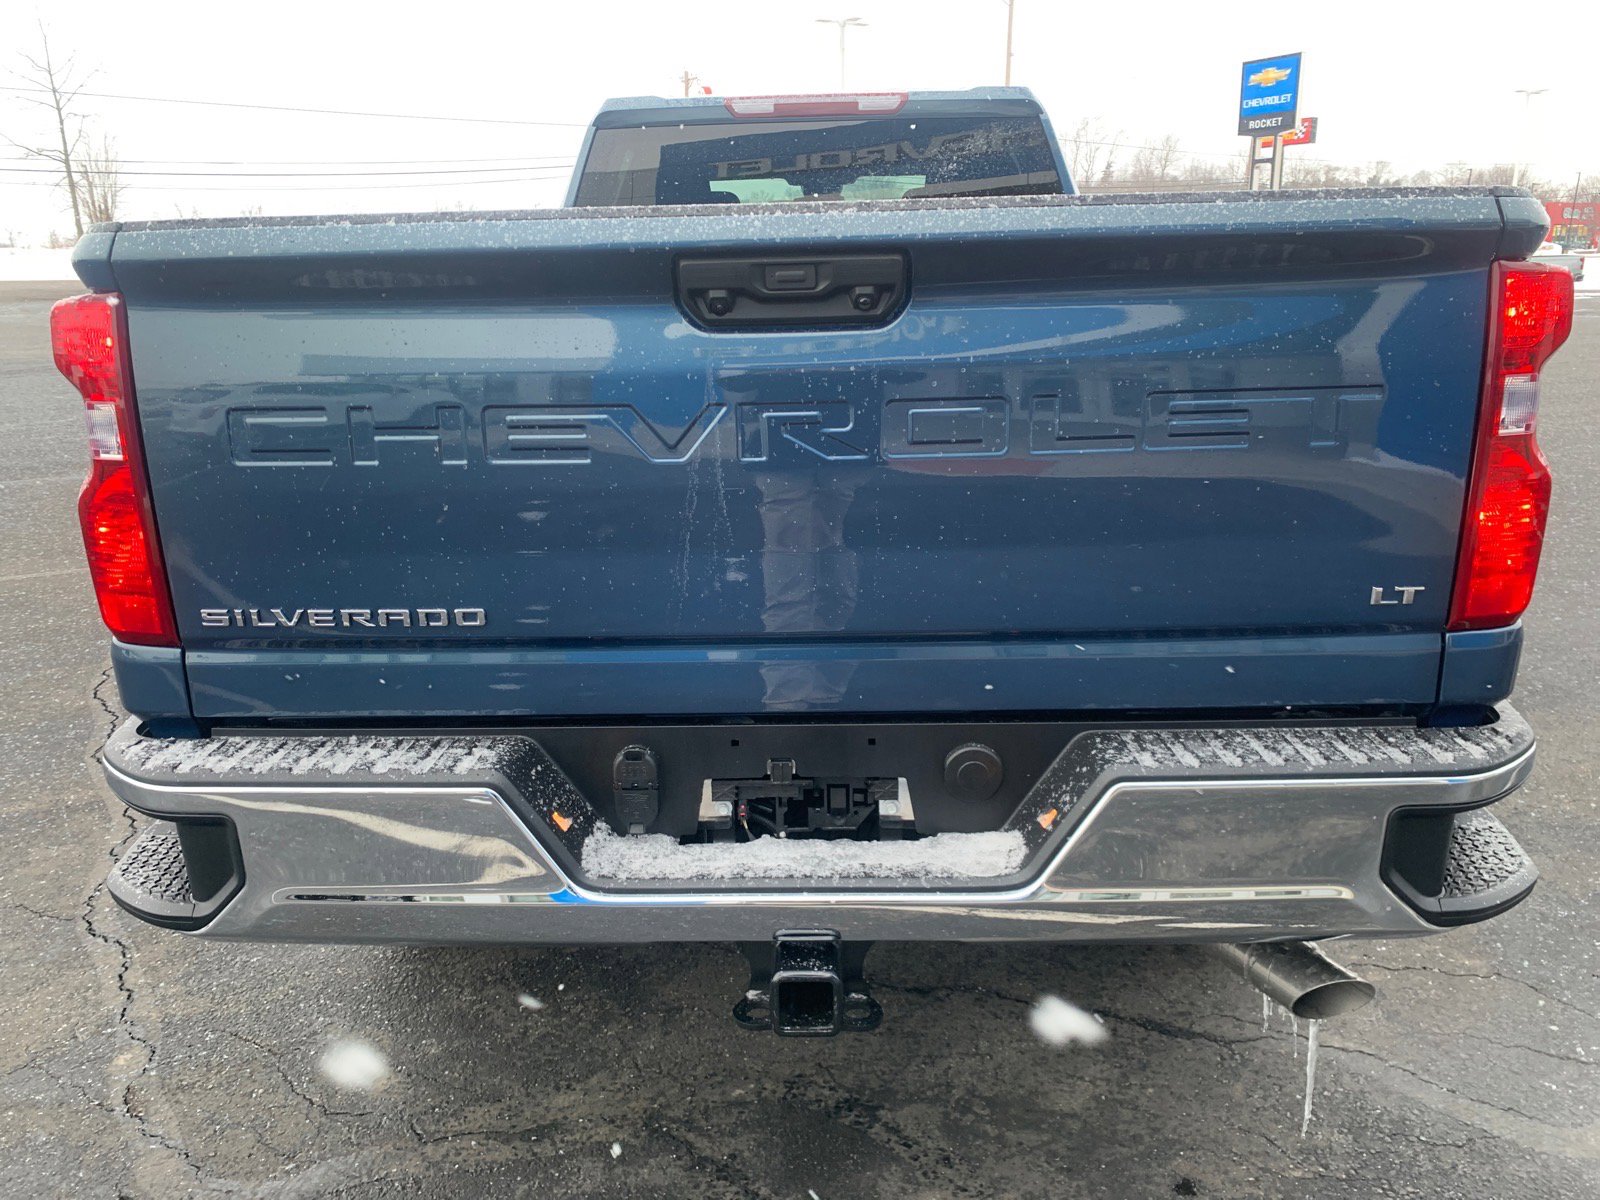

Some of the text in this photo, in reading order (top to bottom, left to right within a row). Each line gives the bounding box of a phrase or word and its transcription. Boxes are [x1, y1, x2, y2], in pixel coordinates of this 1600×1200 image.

[1243, 93, 1292, 108] CHEVROLET
[1249, 117, 1283, 129] ROCKET
[226, 384, 1385, 466] CHEVROLET
[1370, 586, 1425, 605] LT
[200, 608, 487, 627] SILVERADO
